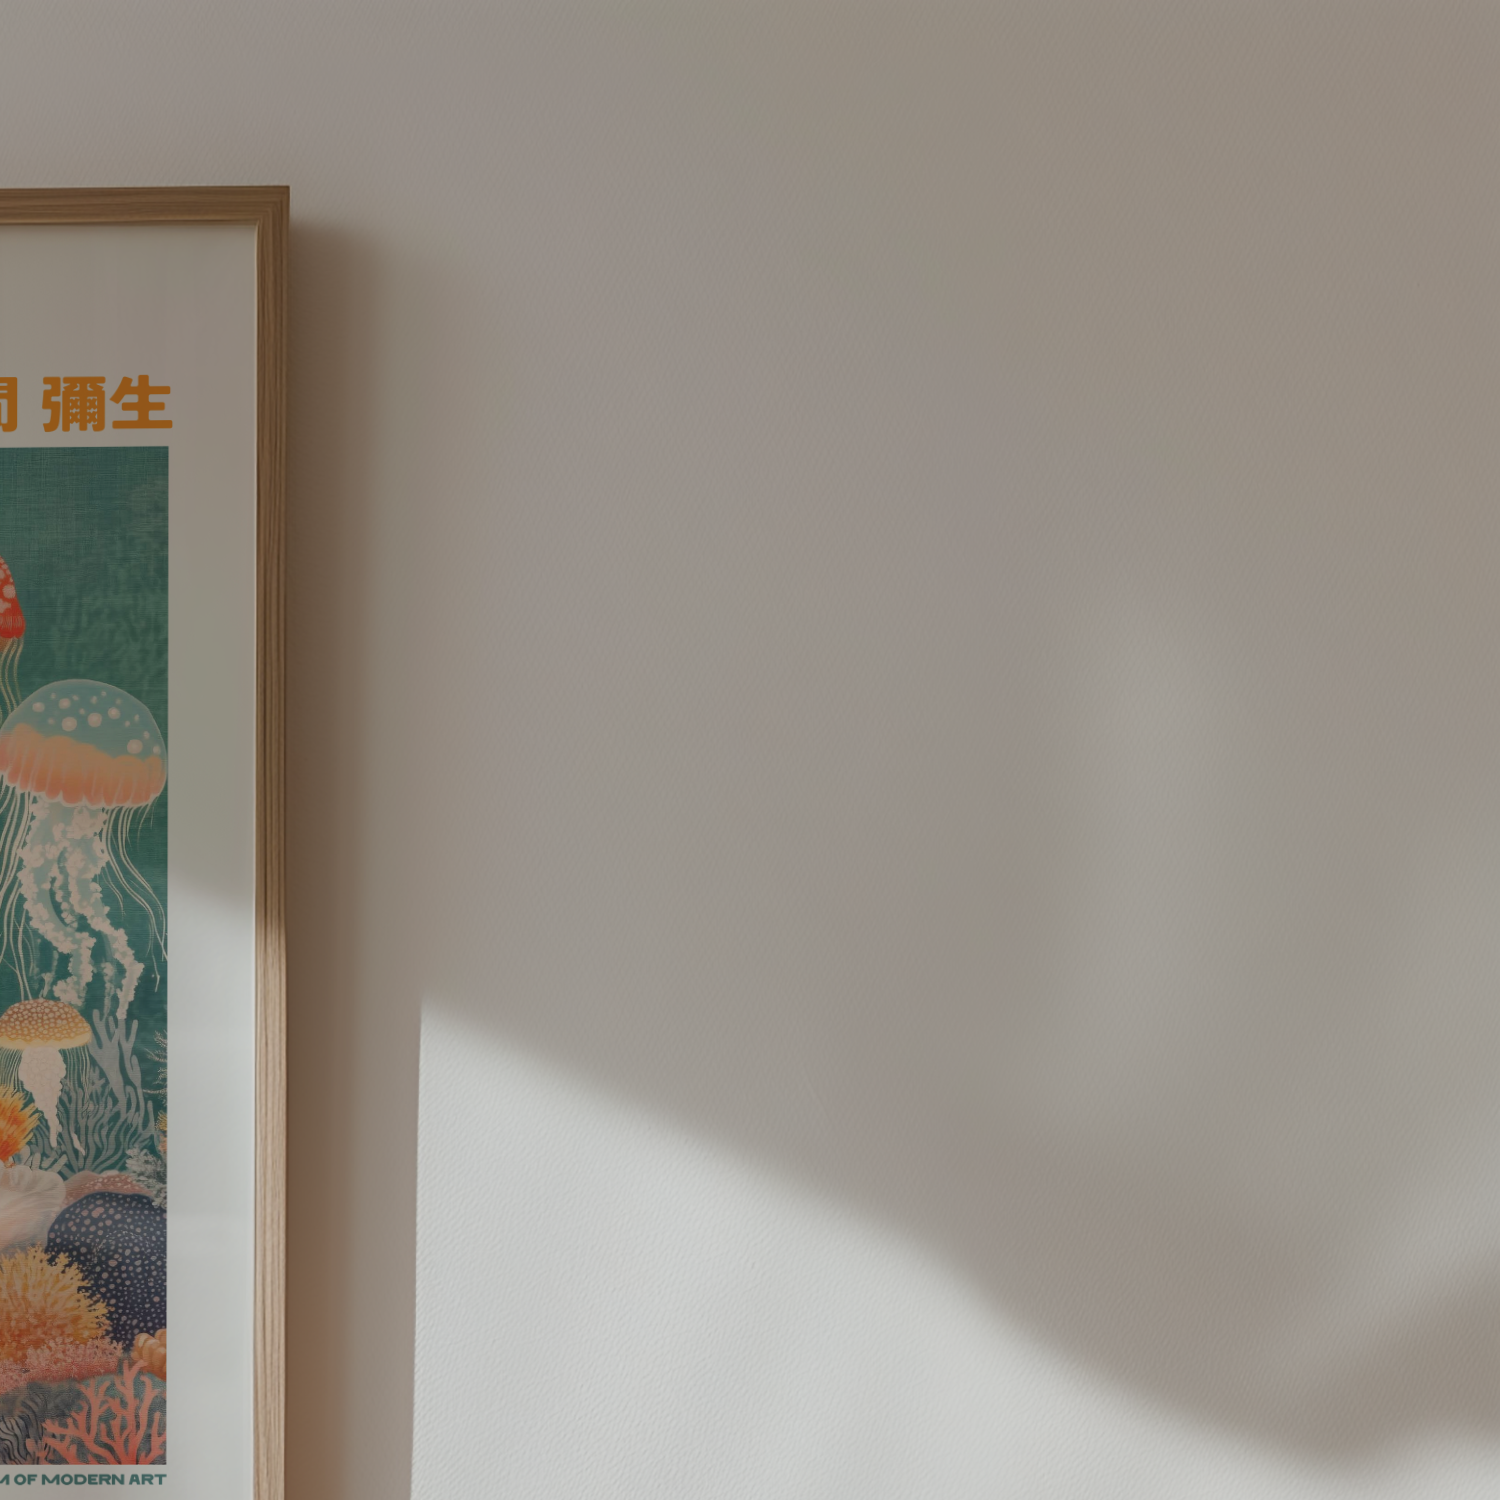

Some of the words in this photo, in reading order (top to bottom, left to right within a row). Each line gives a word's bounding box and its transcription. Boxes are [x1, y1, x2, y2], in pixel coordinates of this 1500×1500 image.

[41, 374, 173, 433] 彌生
[13, 1473, 38, 1486] OF
[41, 1473, 125, 1486] MODERN
[128, 1473, 168, 1486] ART
